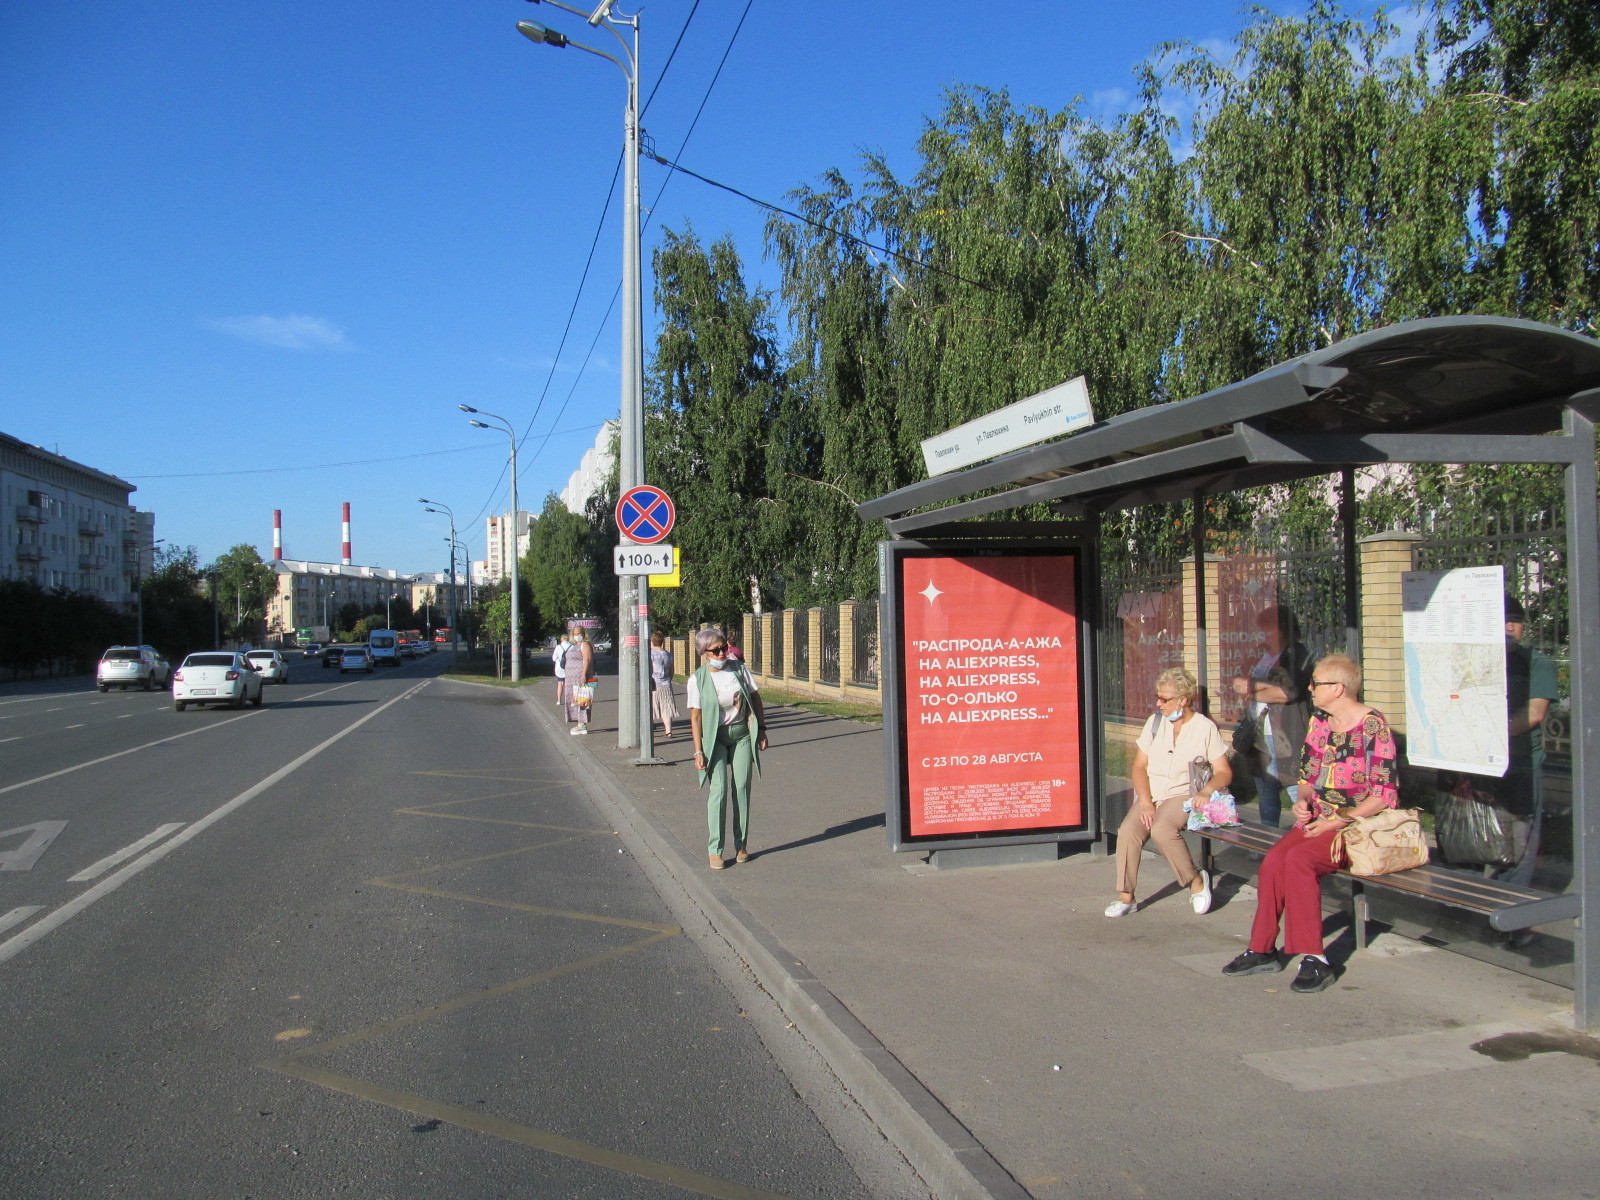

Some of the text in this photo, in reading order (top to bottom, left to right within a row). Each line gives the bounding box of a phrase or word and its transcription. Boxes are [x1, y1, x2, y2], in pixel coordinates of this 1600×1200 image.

[1023, 404, 1064, 425] Pavlyukhin str.
[628, 554, 652, 566] 100
[912, 636, 1062, 652] "РАСПРОДА-А-АЖА
[920, 654, 1040, 670] НА ALIEXPRESS,
[920, 672, 1040, 688] НА ALIEXPRESS,
[920, 691, 1018, 706] ТО-О-ОЛЬКО
[920, 708, 1054, 724] НА ALIEXPRESS..."
[922, 752, 1043, 768] С 23 ПО 28 АВГУСТА
[1052, 779, 1066, 787] 18+
